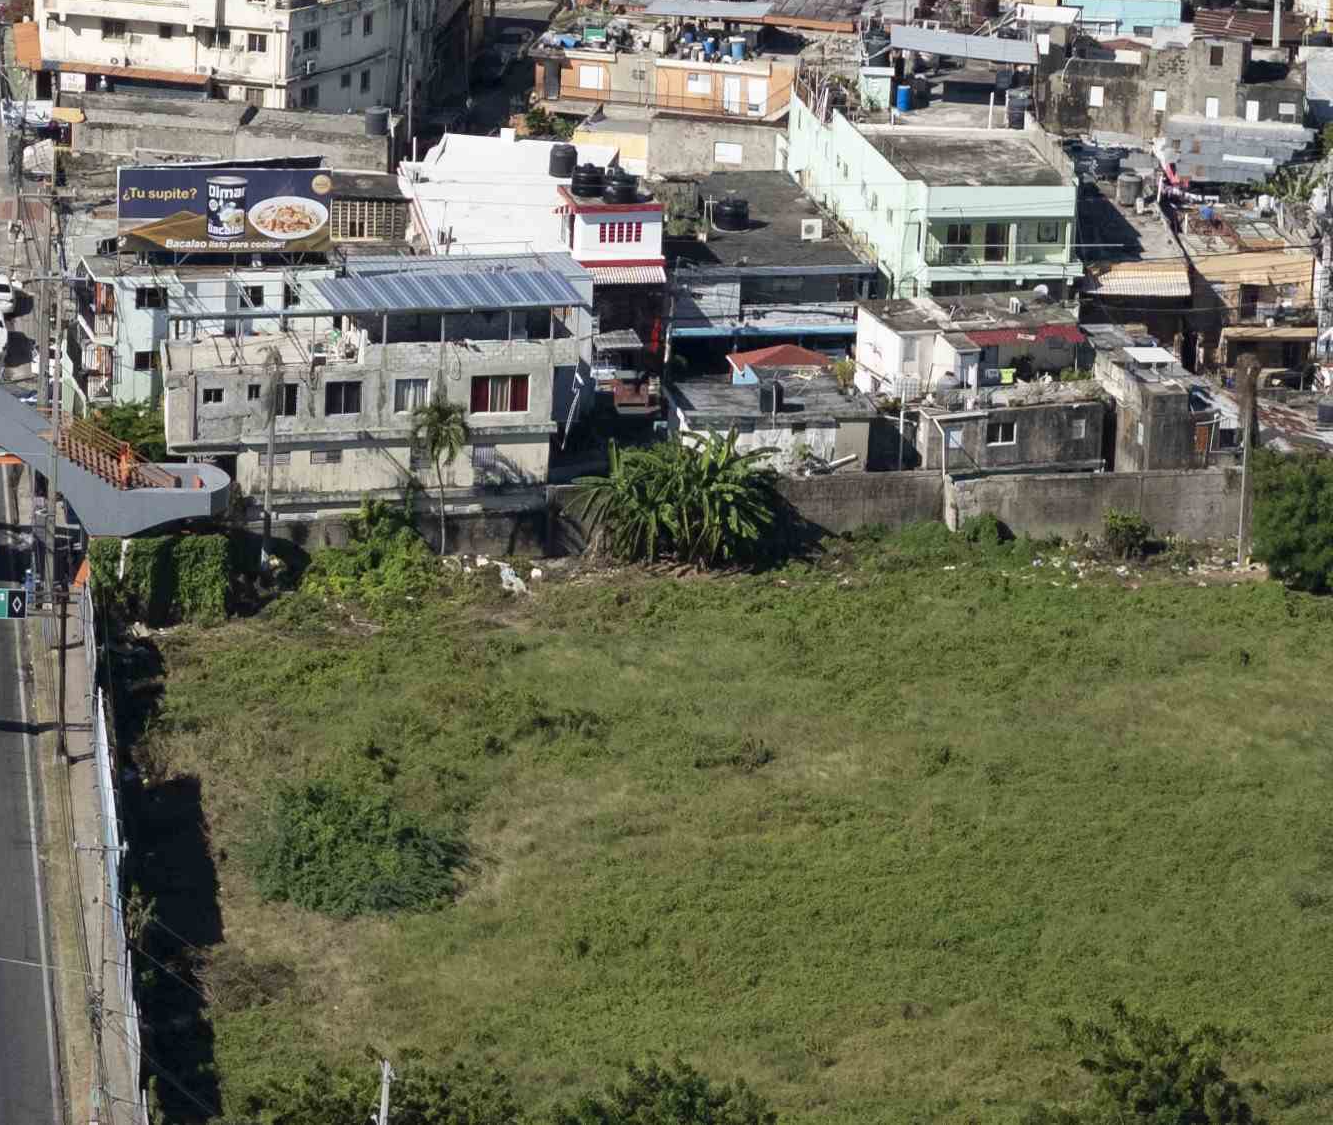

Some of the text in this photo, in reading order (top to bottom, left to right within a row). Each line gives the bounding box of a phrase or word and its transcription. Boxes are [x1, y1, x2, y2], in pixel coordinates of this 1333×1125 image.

[122, 187, 198, 202] ¿Tu supite?
[165, 239, 207, 249] Bacalao
[229, 241, 249, 251] para
